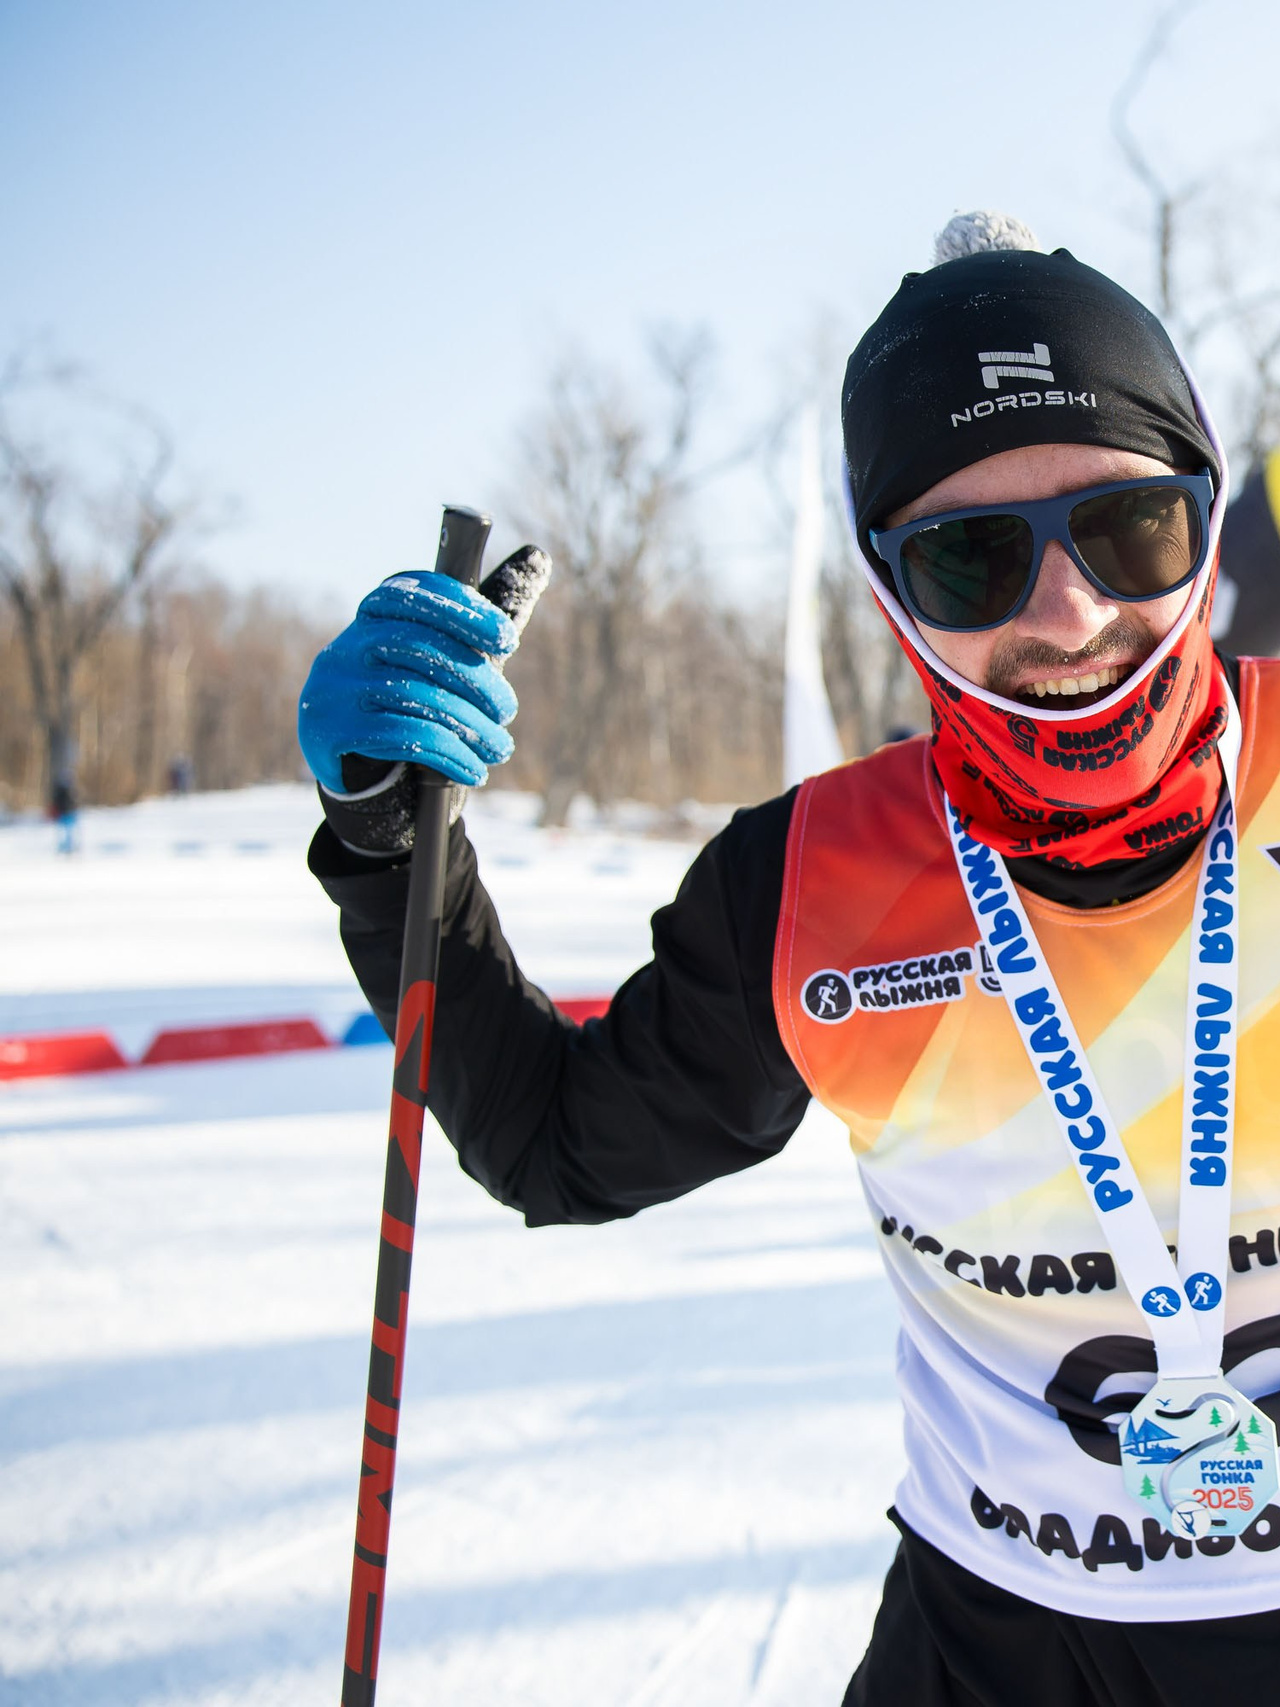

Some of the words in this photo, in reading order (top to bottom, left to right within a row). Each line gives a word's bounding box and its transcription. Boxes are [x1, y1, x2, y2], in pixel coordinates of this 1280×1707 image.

[950, 390, 1097, 428] NORDSKI
[949, 803, 1037, 975] ЛЫЖ
[1198, 800, 1235, 965] ССКАЯ
[852, 950, 973, 990] РУССКАЯ
[858, 976, 962, 1008] ЛЫЖНЯ
[1014, 986, 1134, 1213] РУССКАЯ
[1190, 982, 1234, 1187] ЛЫЖНЯ
[1199, 1459, 1264, 1472] РУССКАЯ
[1201, 1471, 1256, 1485] ГОНКА
[1192, 1486, 1255, 1512] 2025
